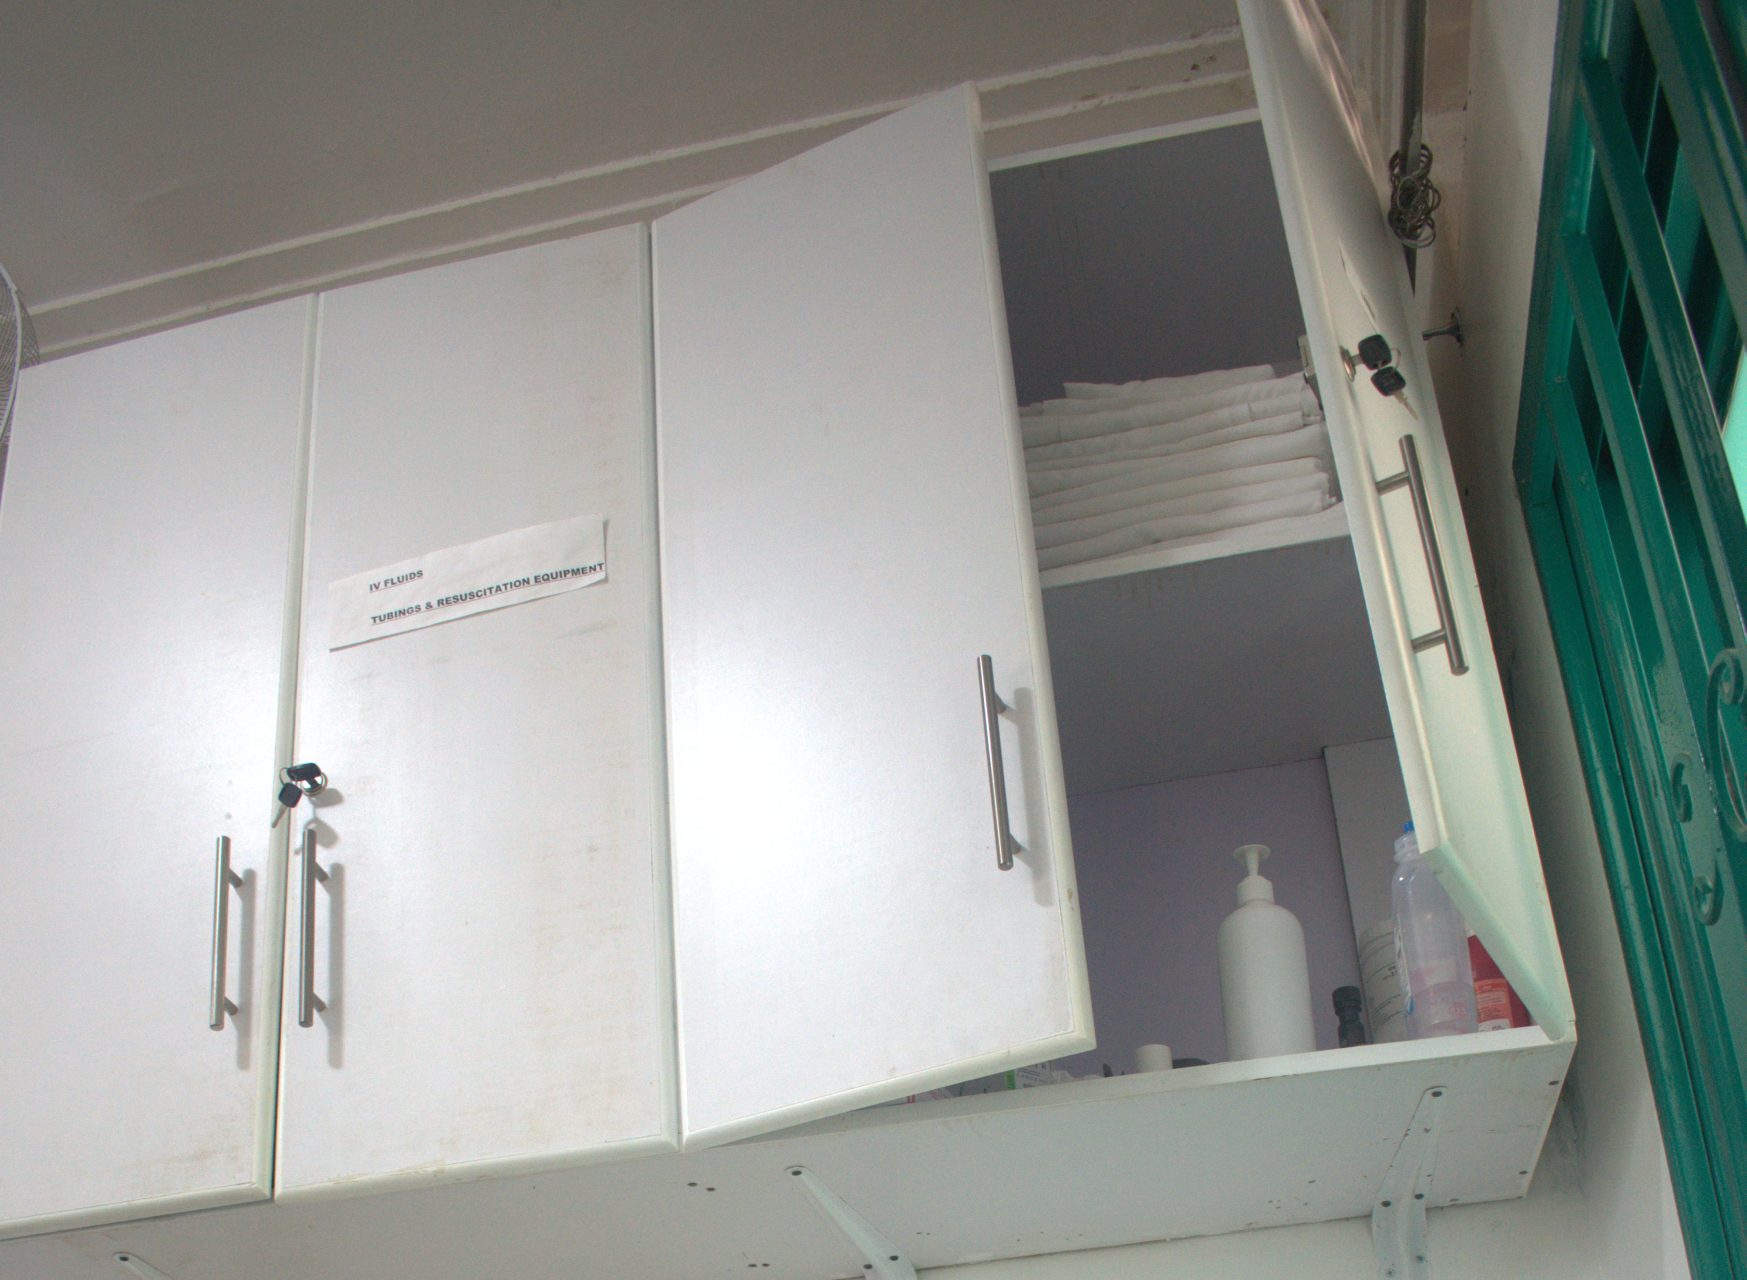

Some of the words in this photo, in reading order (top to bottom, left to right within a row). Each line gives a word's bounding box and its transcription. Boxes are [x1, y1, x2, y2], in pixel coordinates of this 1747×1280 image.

[369, 582, 381, 592] IV
[384, 570, 424, 587] FLUIDS
[371, 604, 421, 624] TUBINGS
[425, 601, 433, 610] &
[437, 577, 530, 607] RESUSCITATION
[534, 563, 604, 584] EQUIPMENT
